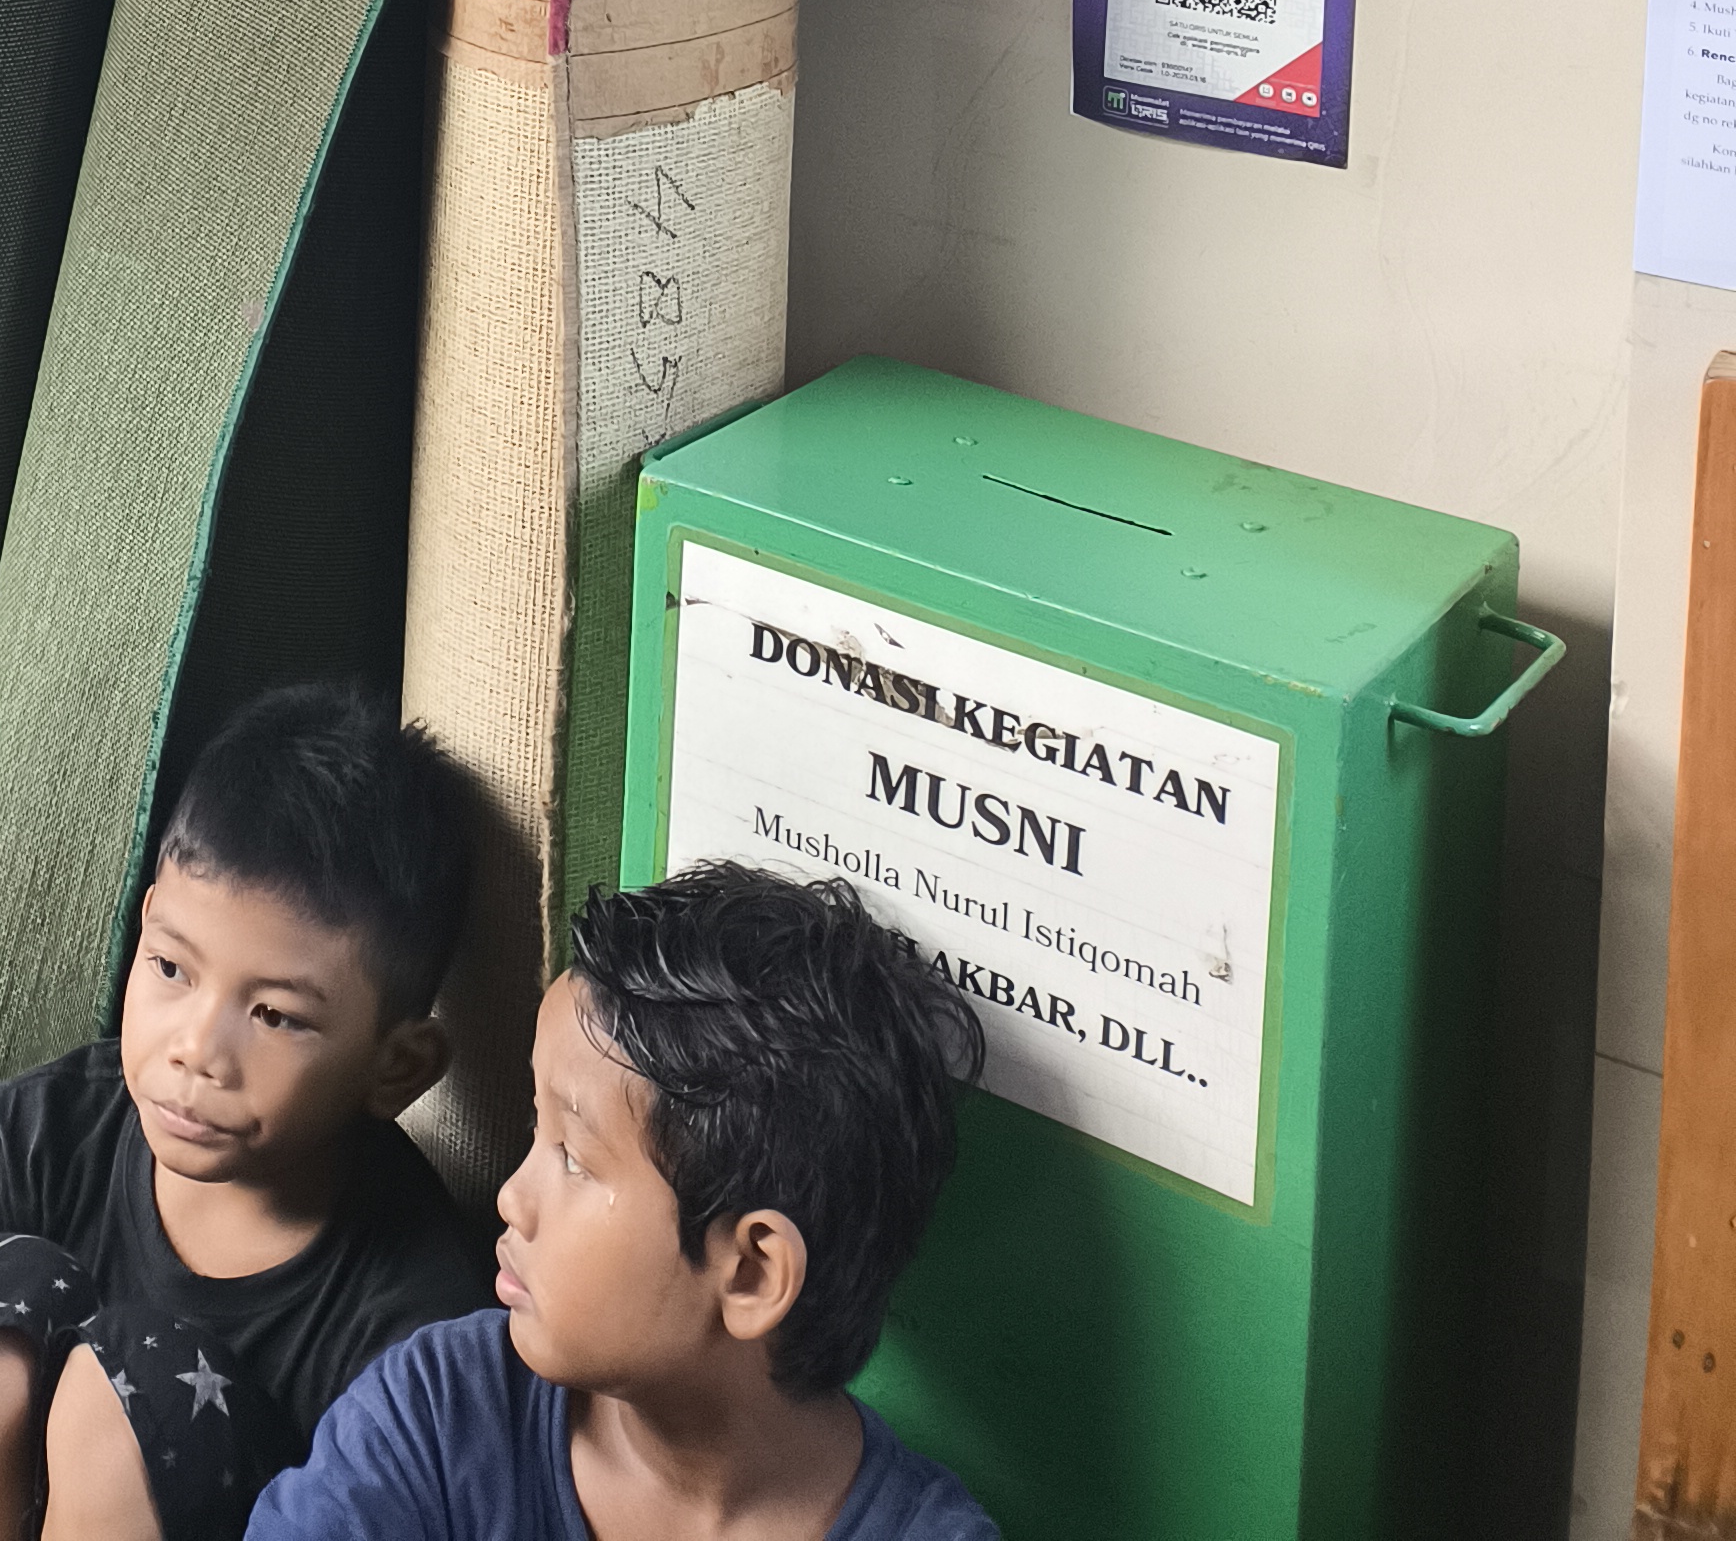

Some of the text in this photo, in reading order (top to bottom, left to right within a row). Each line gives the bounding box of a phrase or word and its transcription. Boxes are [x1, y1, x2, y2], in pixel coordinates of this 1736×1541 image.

[750, 623, 1230, 825] DONASI KEGIATAN
[865, 752, 1086, 878] MUSNI
[753, 805, 1202, 1005] Musholla Nurul Istiqomah
[927, 949, 1087, 1042] AKBAR,
[1100, 1015, 1208, 1088] DLL..
